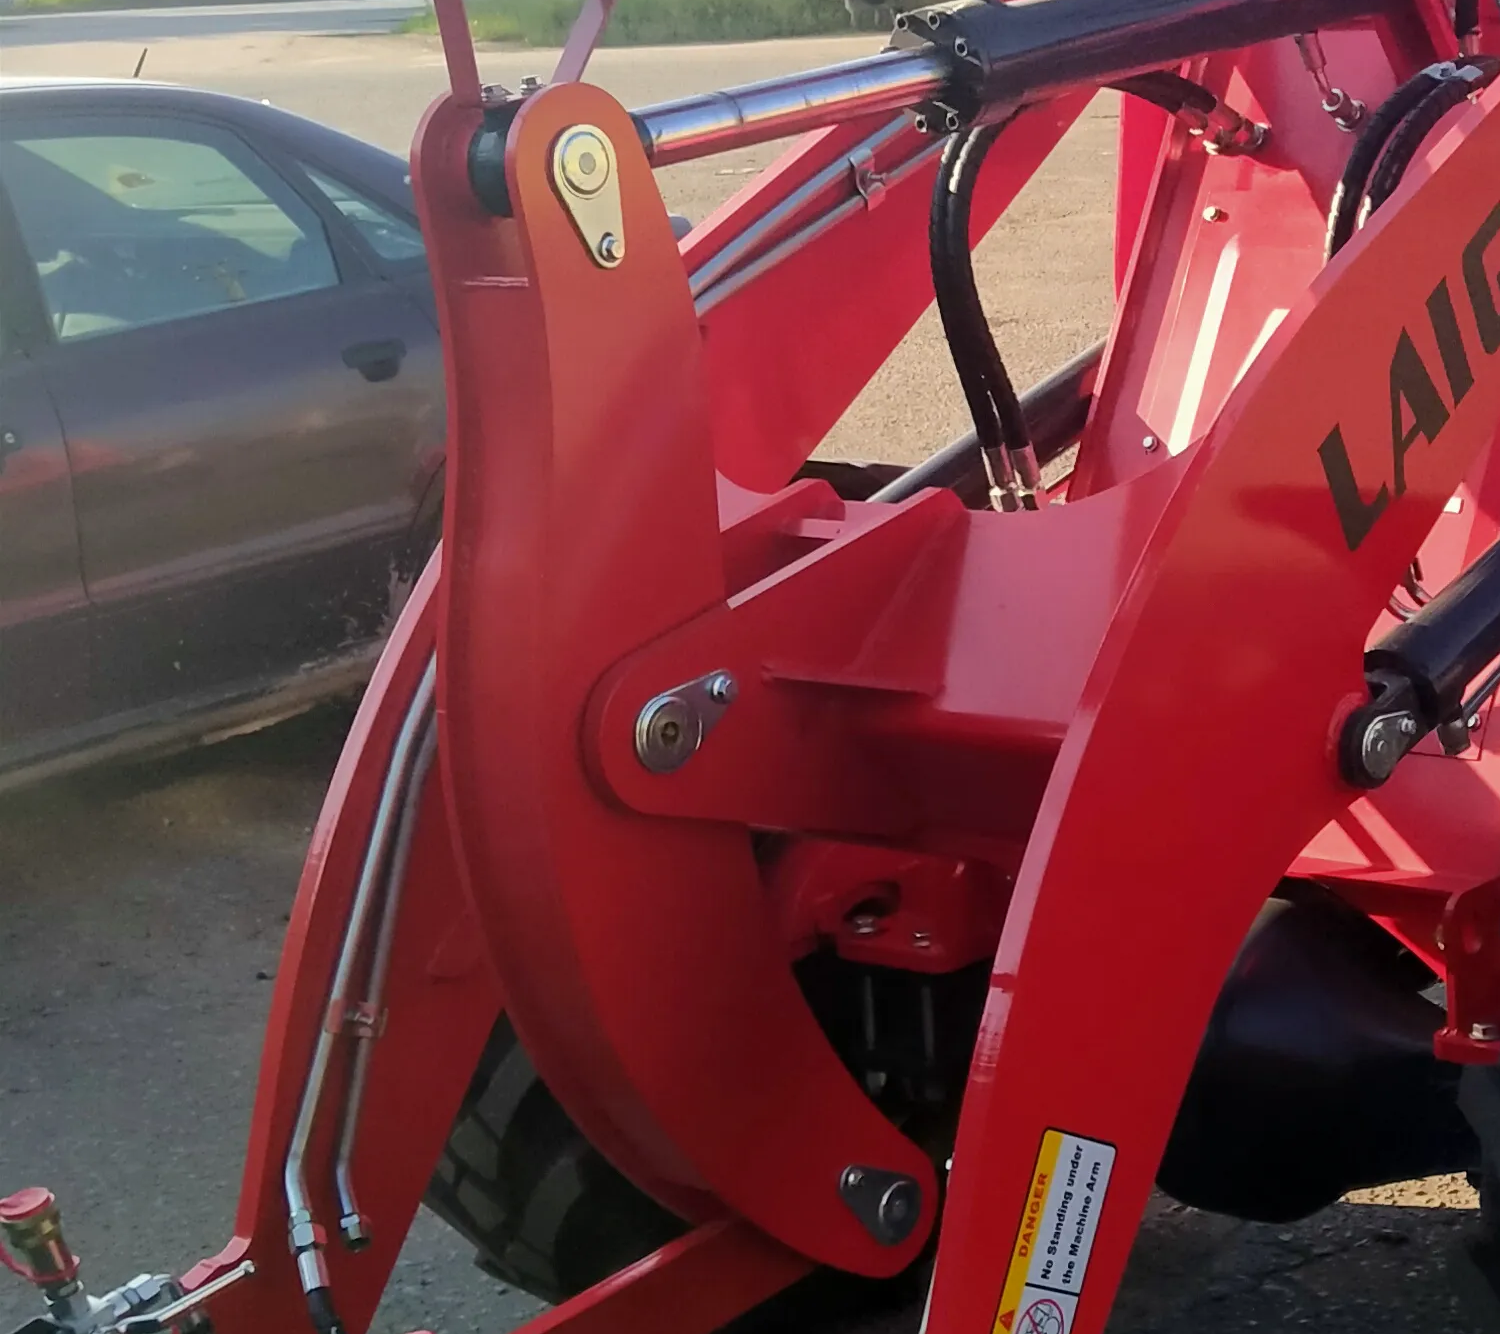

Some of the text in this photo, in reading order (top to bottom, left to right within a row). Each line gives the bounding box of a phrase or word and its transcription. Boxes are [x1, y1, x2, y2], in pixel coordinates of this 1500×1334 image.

[1019, 1173, 1049, 1257] DANGER
[1041, 1144, 1084, 1280] No Standing under
[1062, 1161, 1102, 1285] the Machine Arm
